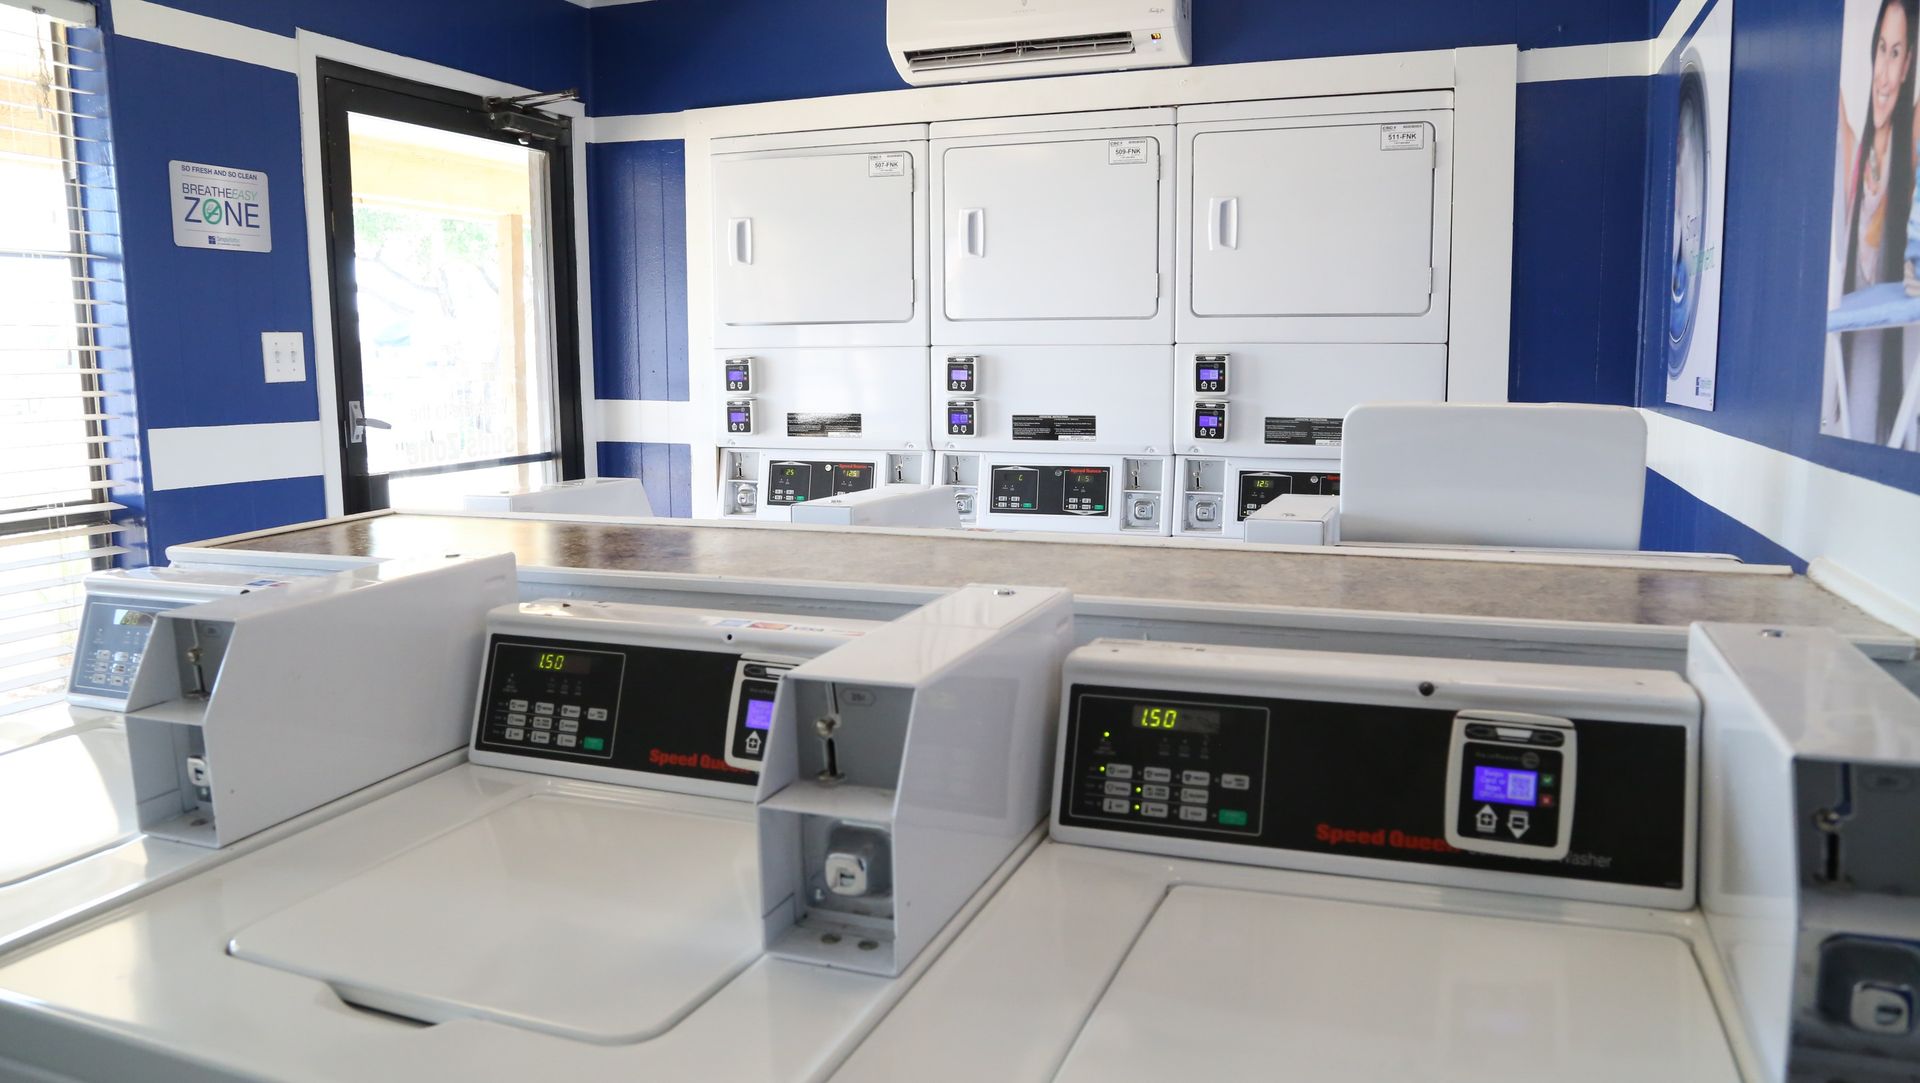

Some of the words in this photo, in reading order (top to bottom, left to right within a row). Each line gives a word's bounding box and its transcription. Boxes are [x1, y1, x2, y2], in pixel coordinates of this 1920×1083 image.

[181, 164, 191, 172] SO
[191, 165, 213, 175] FRESH
[213, 169, 227, 177] AND
[237, 172, 258, 180] CLEAN
[184, 196, 260, 228] ZONE
[1141, 708, 1178, 729] 1.50
[649, 747, 699, 768] Speed
[1315, 823, 1386, 847] Speed
